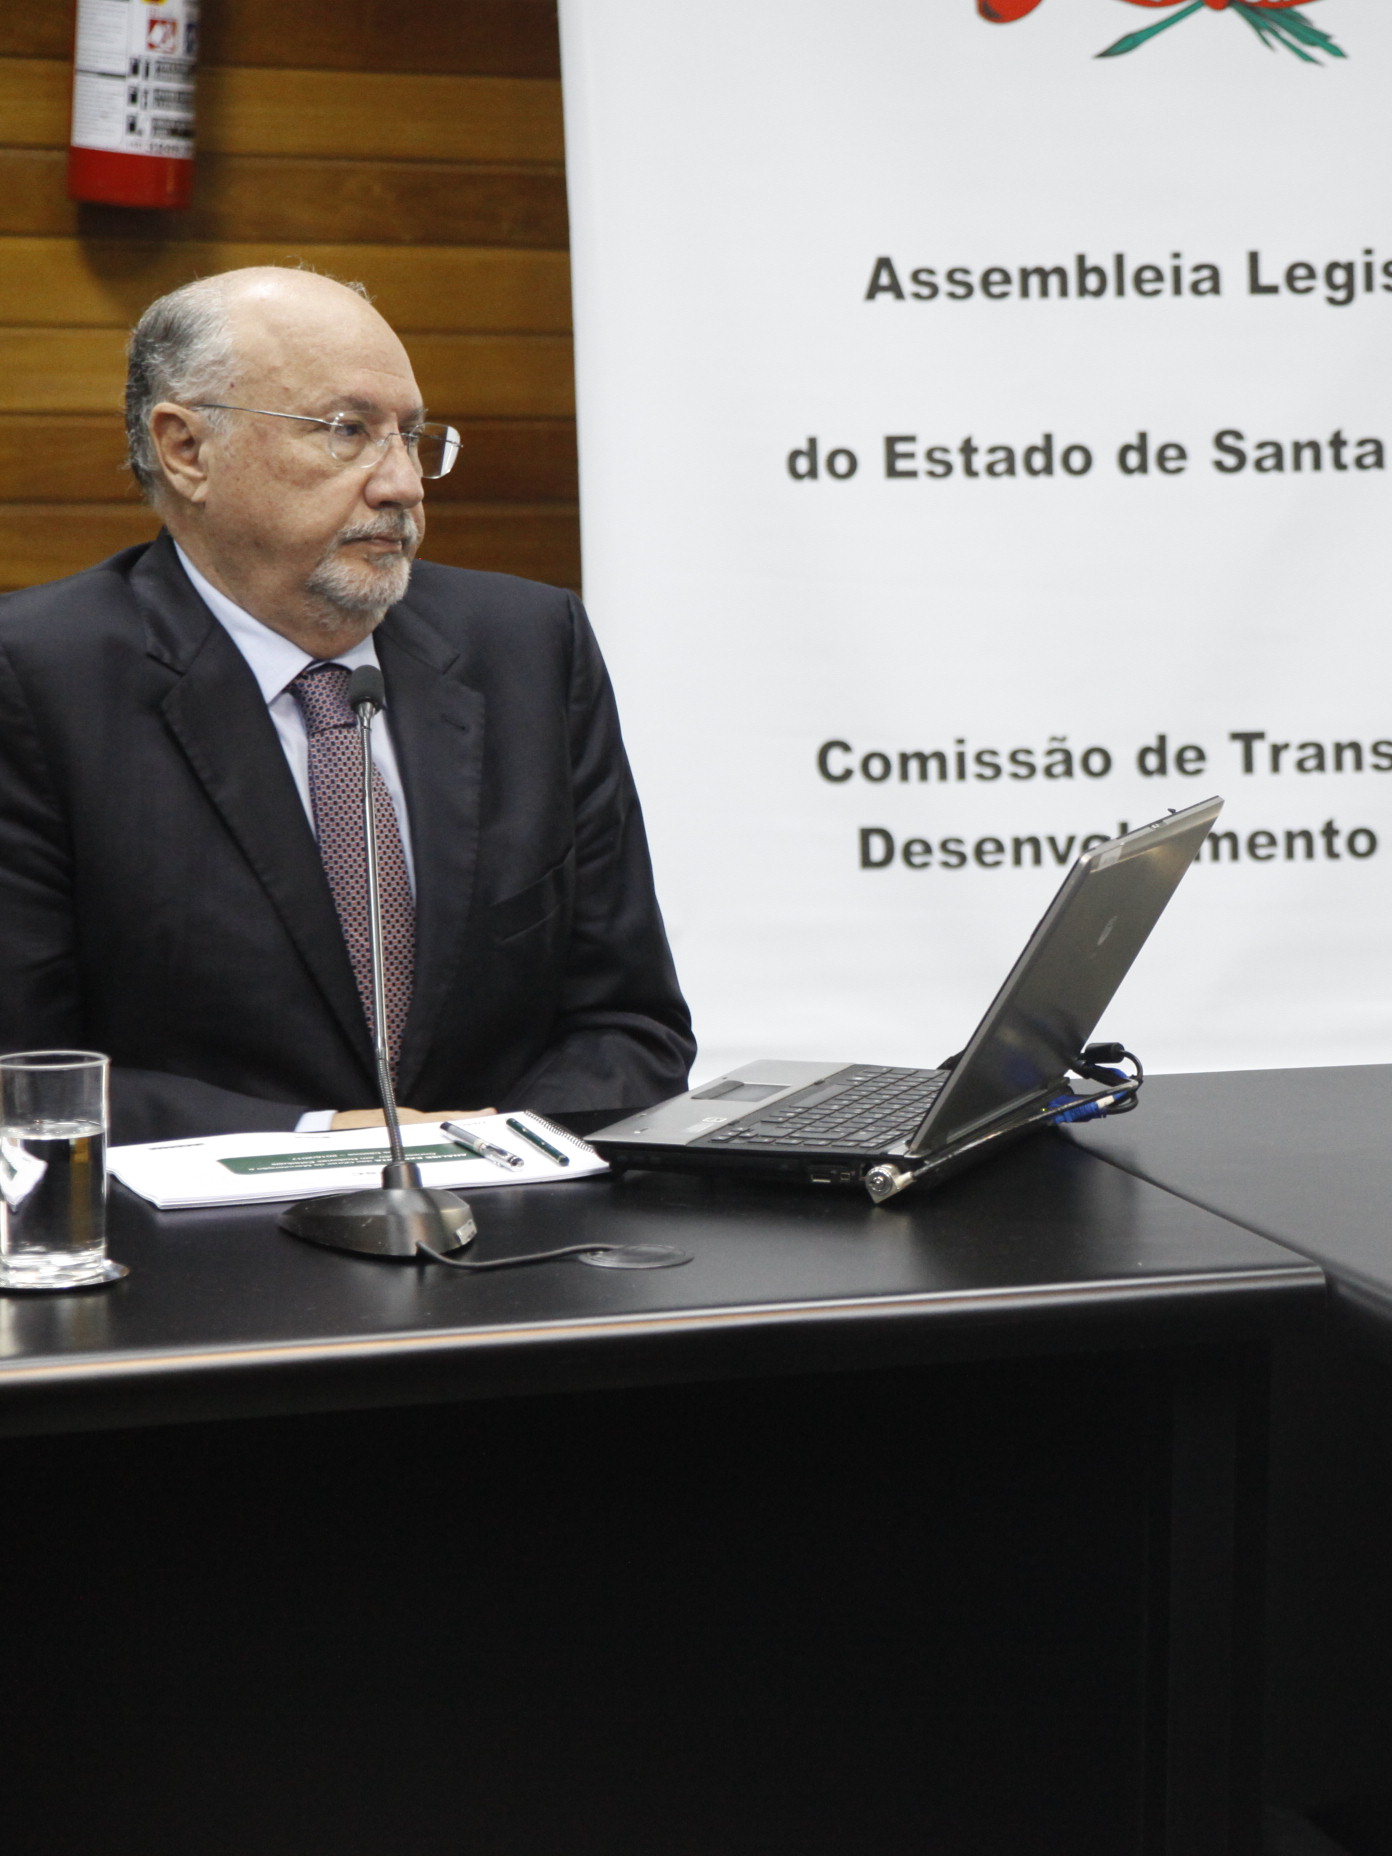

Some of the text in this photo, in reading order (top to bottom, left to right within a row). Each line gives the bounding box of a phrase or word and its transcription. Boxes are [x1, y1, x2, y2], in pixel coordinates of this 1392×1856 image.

[865, 251, 1222, 301] Assembleia
[788, 437, 859, 481] do
[885, 433, 1094, 479] Estado
[1118, 431, 1188, 476] de
[1213, 429, 1385, 474] Santa
[817, 737, 1113, 783] Comissão
[1137, 734, 1207, 777] de
[860, 819, 1379, 870] Desenvmento
